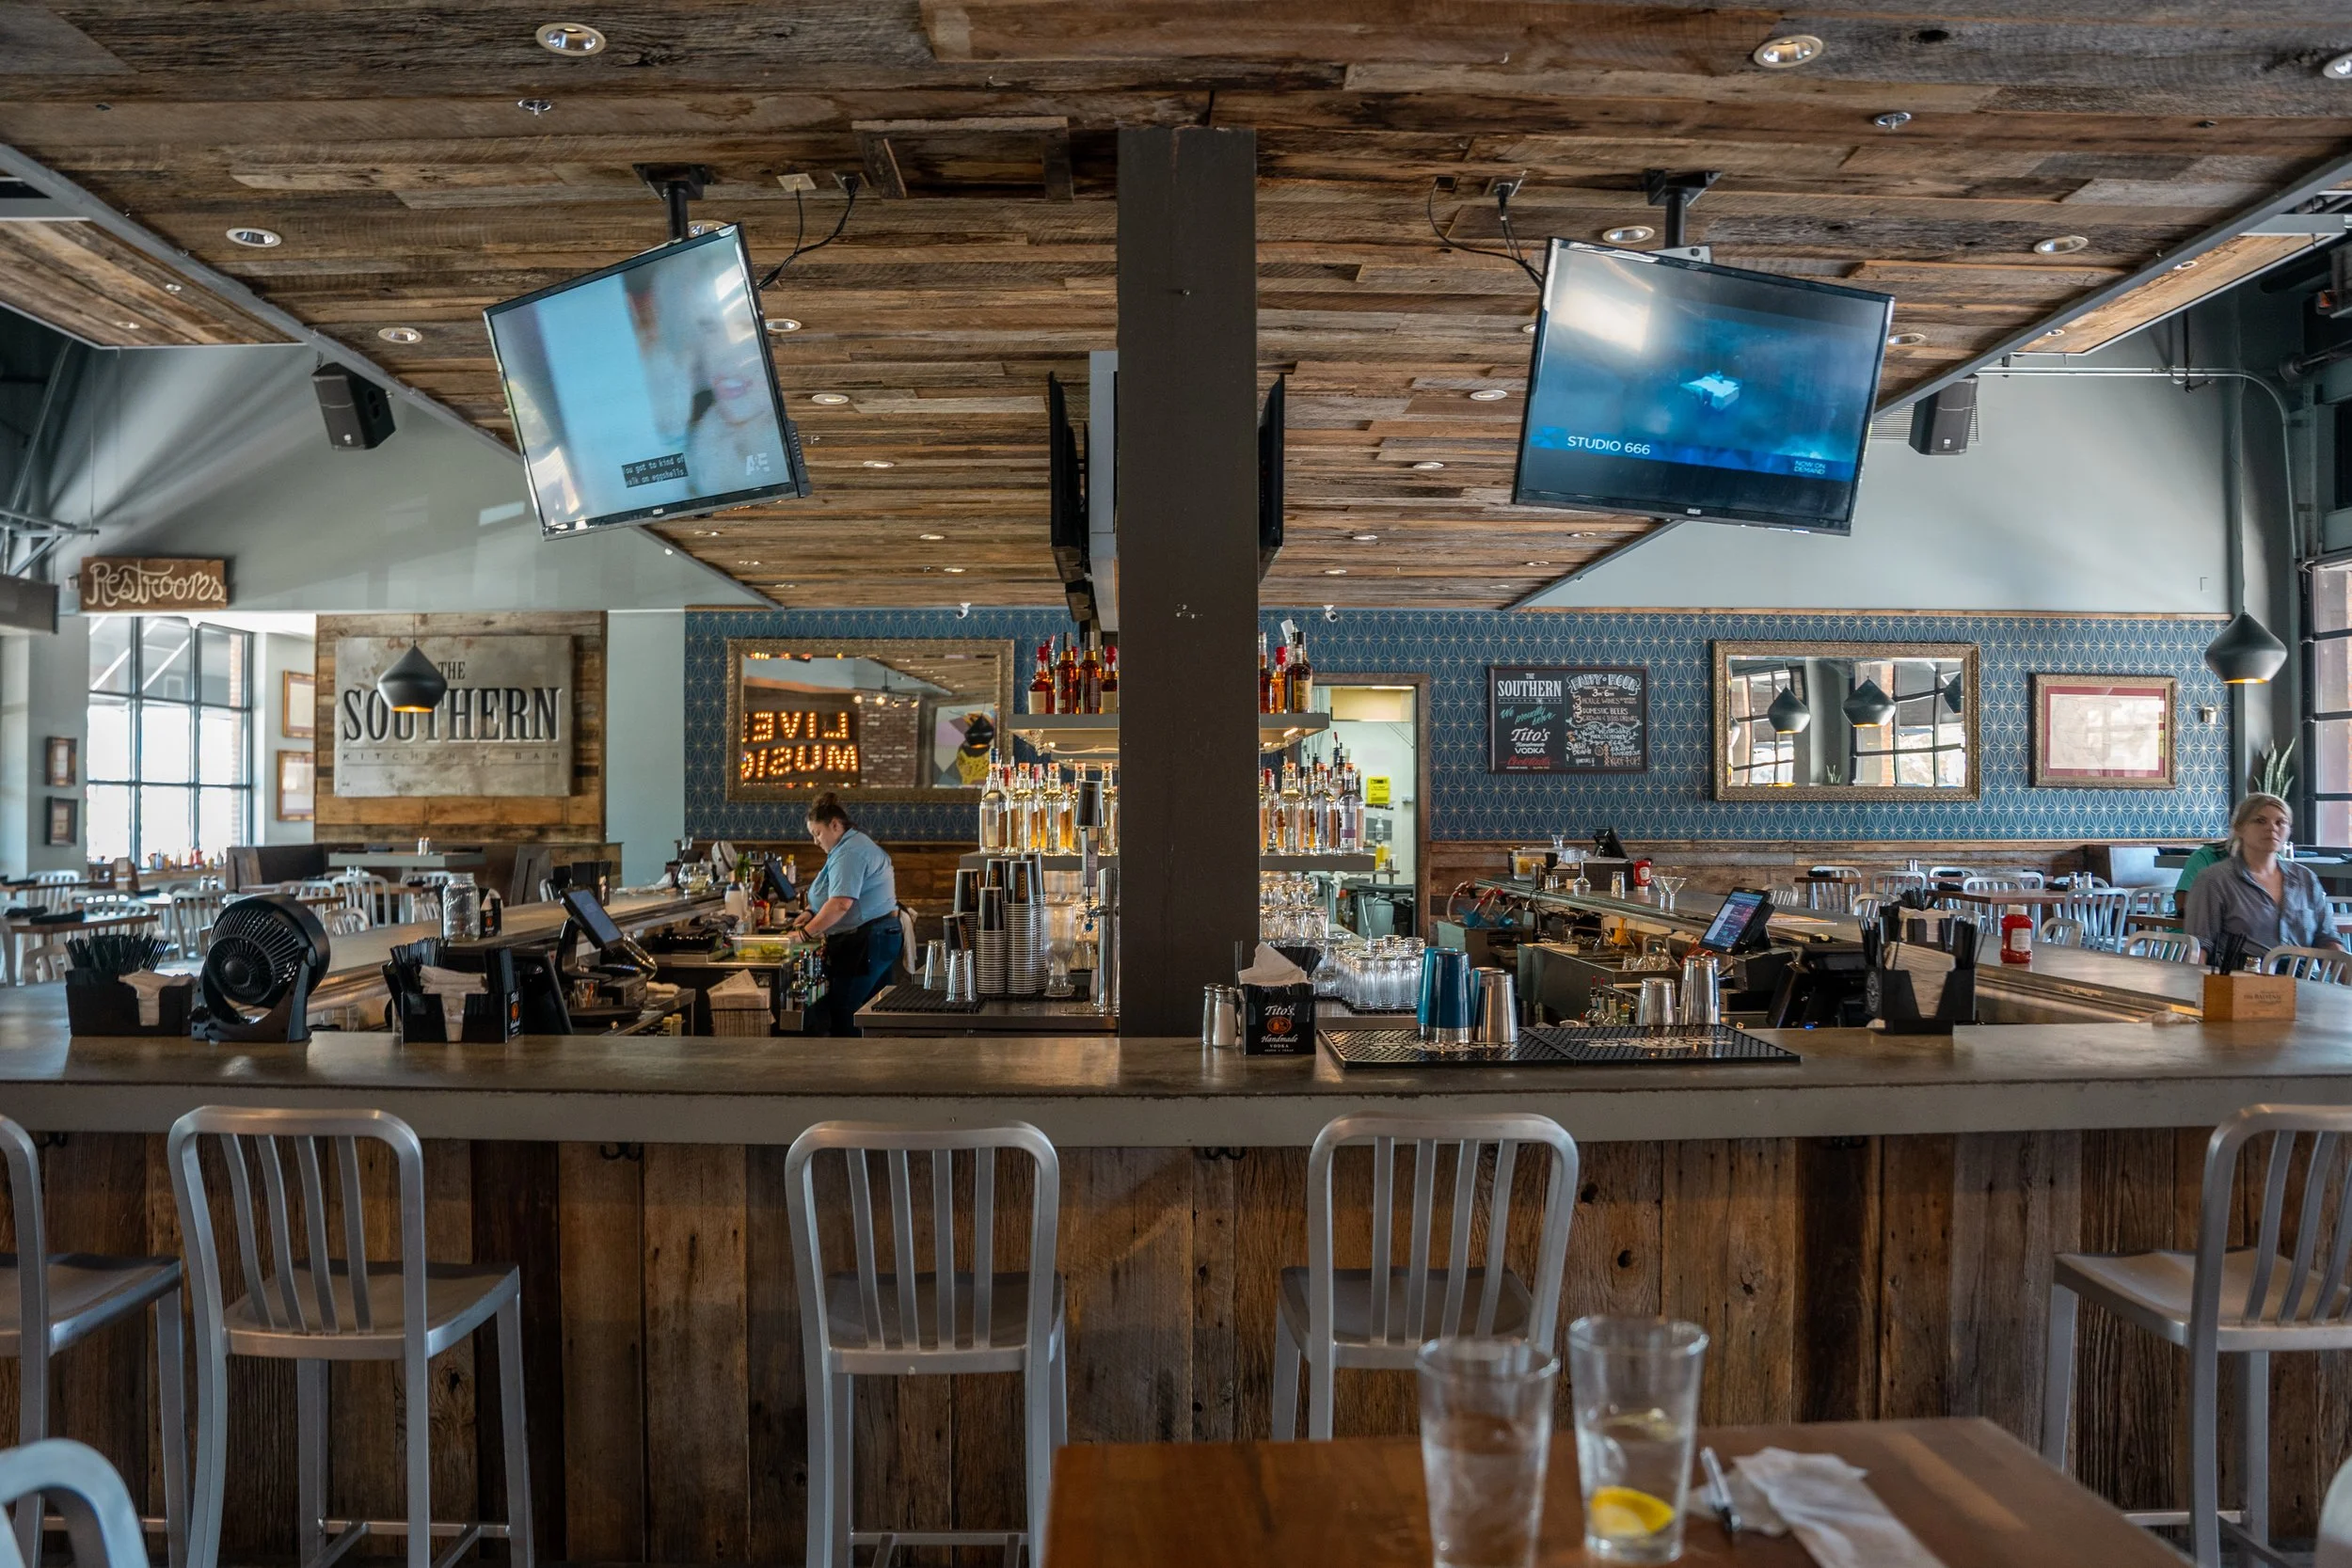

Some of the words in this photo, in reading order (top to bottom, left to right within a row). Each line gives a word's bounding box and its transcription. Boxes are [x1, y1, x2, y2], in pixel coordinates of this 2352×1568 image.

[1566, 436, 1621, 451] STUDIO
[1625, 442, 1651, 455] 666
[1793, 467, 1825, 475] DEMAND
[1794, 460, 1812, 468] NOW
[85, 561, 228, 608] Restrooms
[437, 660, 466, 680] THE
[1497, 680, 1562, 697] SOUTHERN
[343, 688, 563, 743] SOUTHERN
[1510, 727, 1550, 741] Tito's
[1264, 1005, 1295, 1016] Tito's
[1261, 1034, 1298, 1043] Handmade
